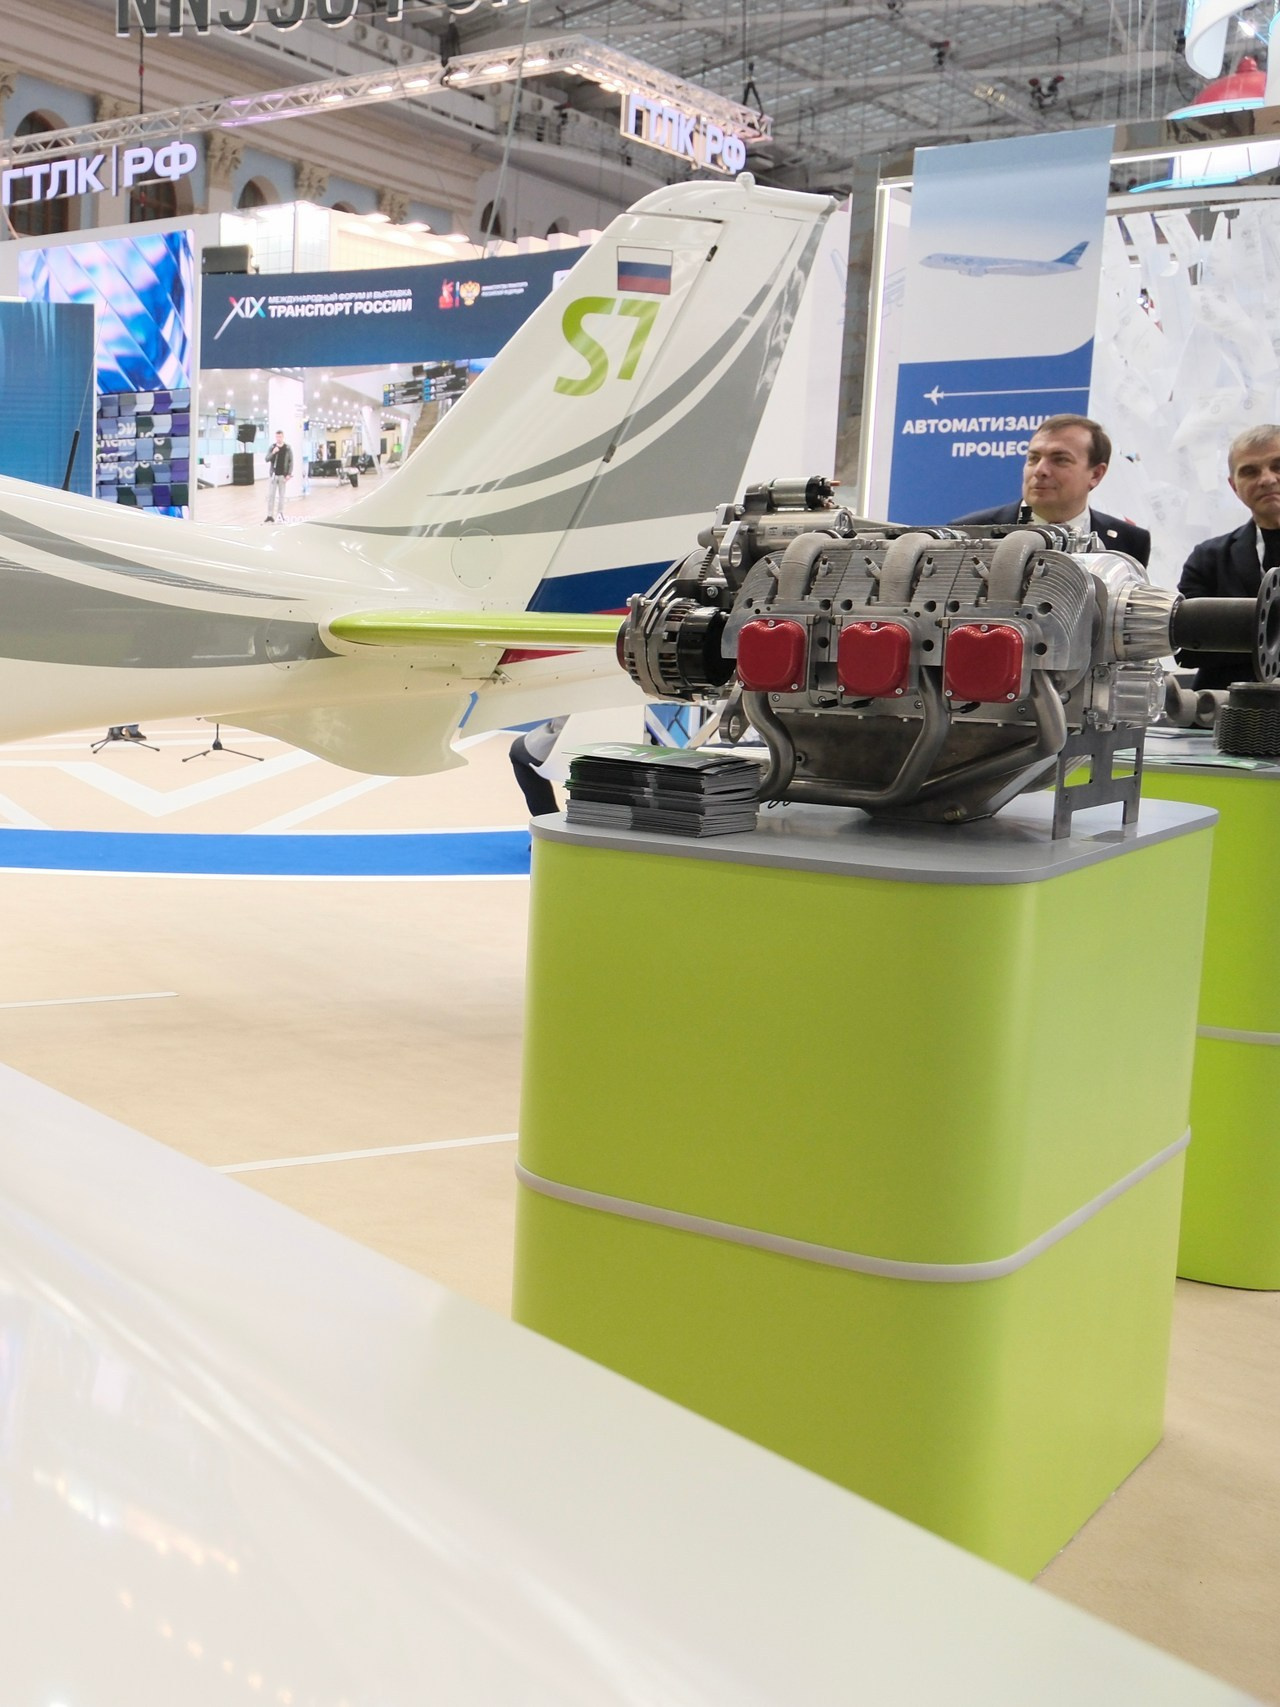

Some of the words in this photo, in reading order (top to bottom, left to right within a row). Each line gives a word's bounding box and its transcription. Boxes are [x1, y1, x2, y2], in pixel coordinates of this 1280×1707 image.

[627, 92, 696, 158] ГТЛК
[705, 123, 747, 175] РФ
[2, 154, 105, 206] ГТЛК
[123, 141, 197, 188] РФ
[268, 302, 352, 318] ТРАНСПОРТ
[354, 298, 413, 315] РОССИИ
[554, 296, 661, 396] S7
[902, 415, 1051, 434] АВТОМАТИЗАЦ
